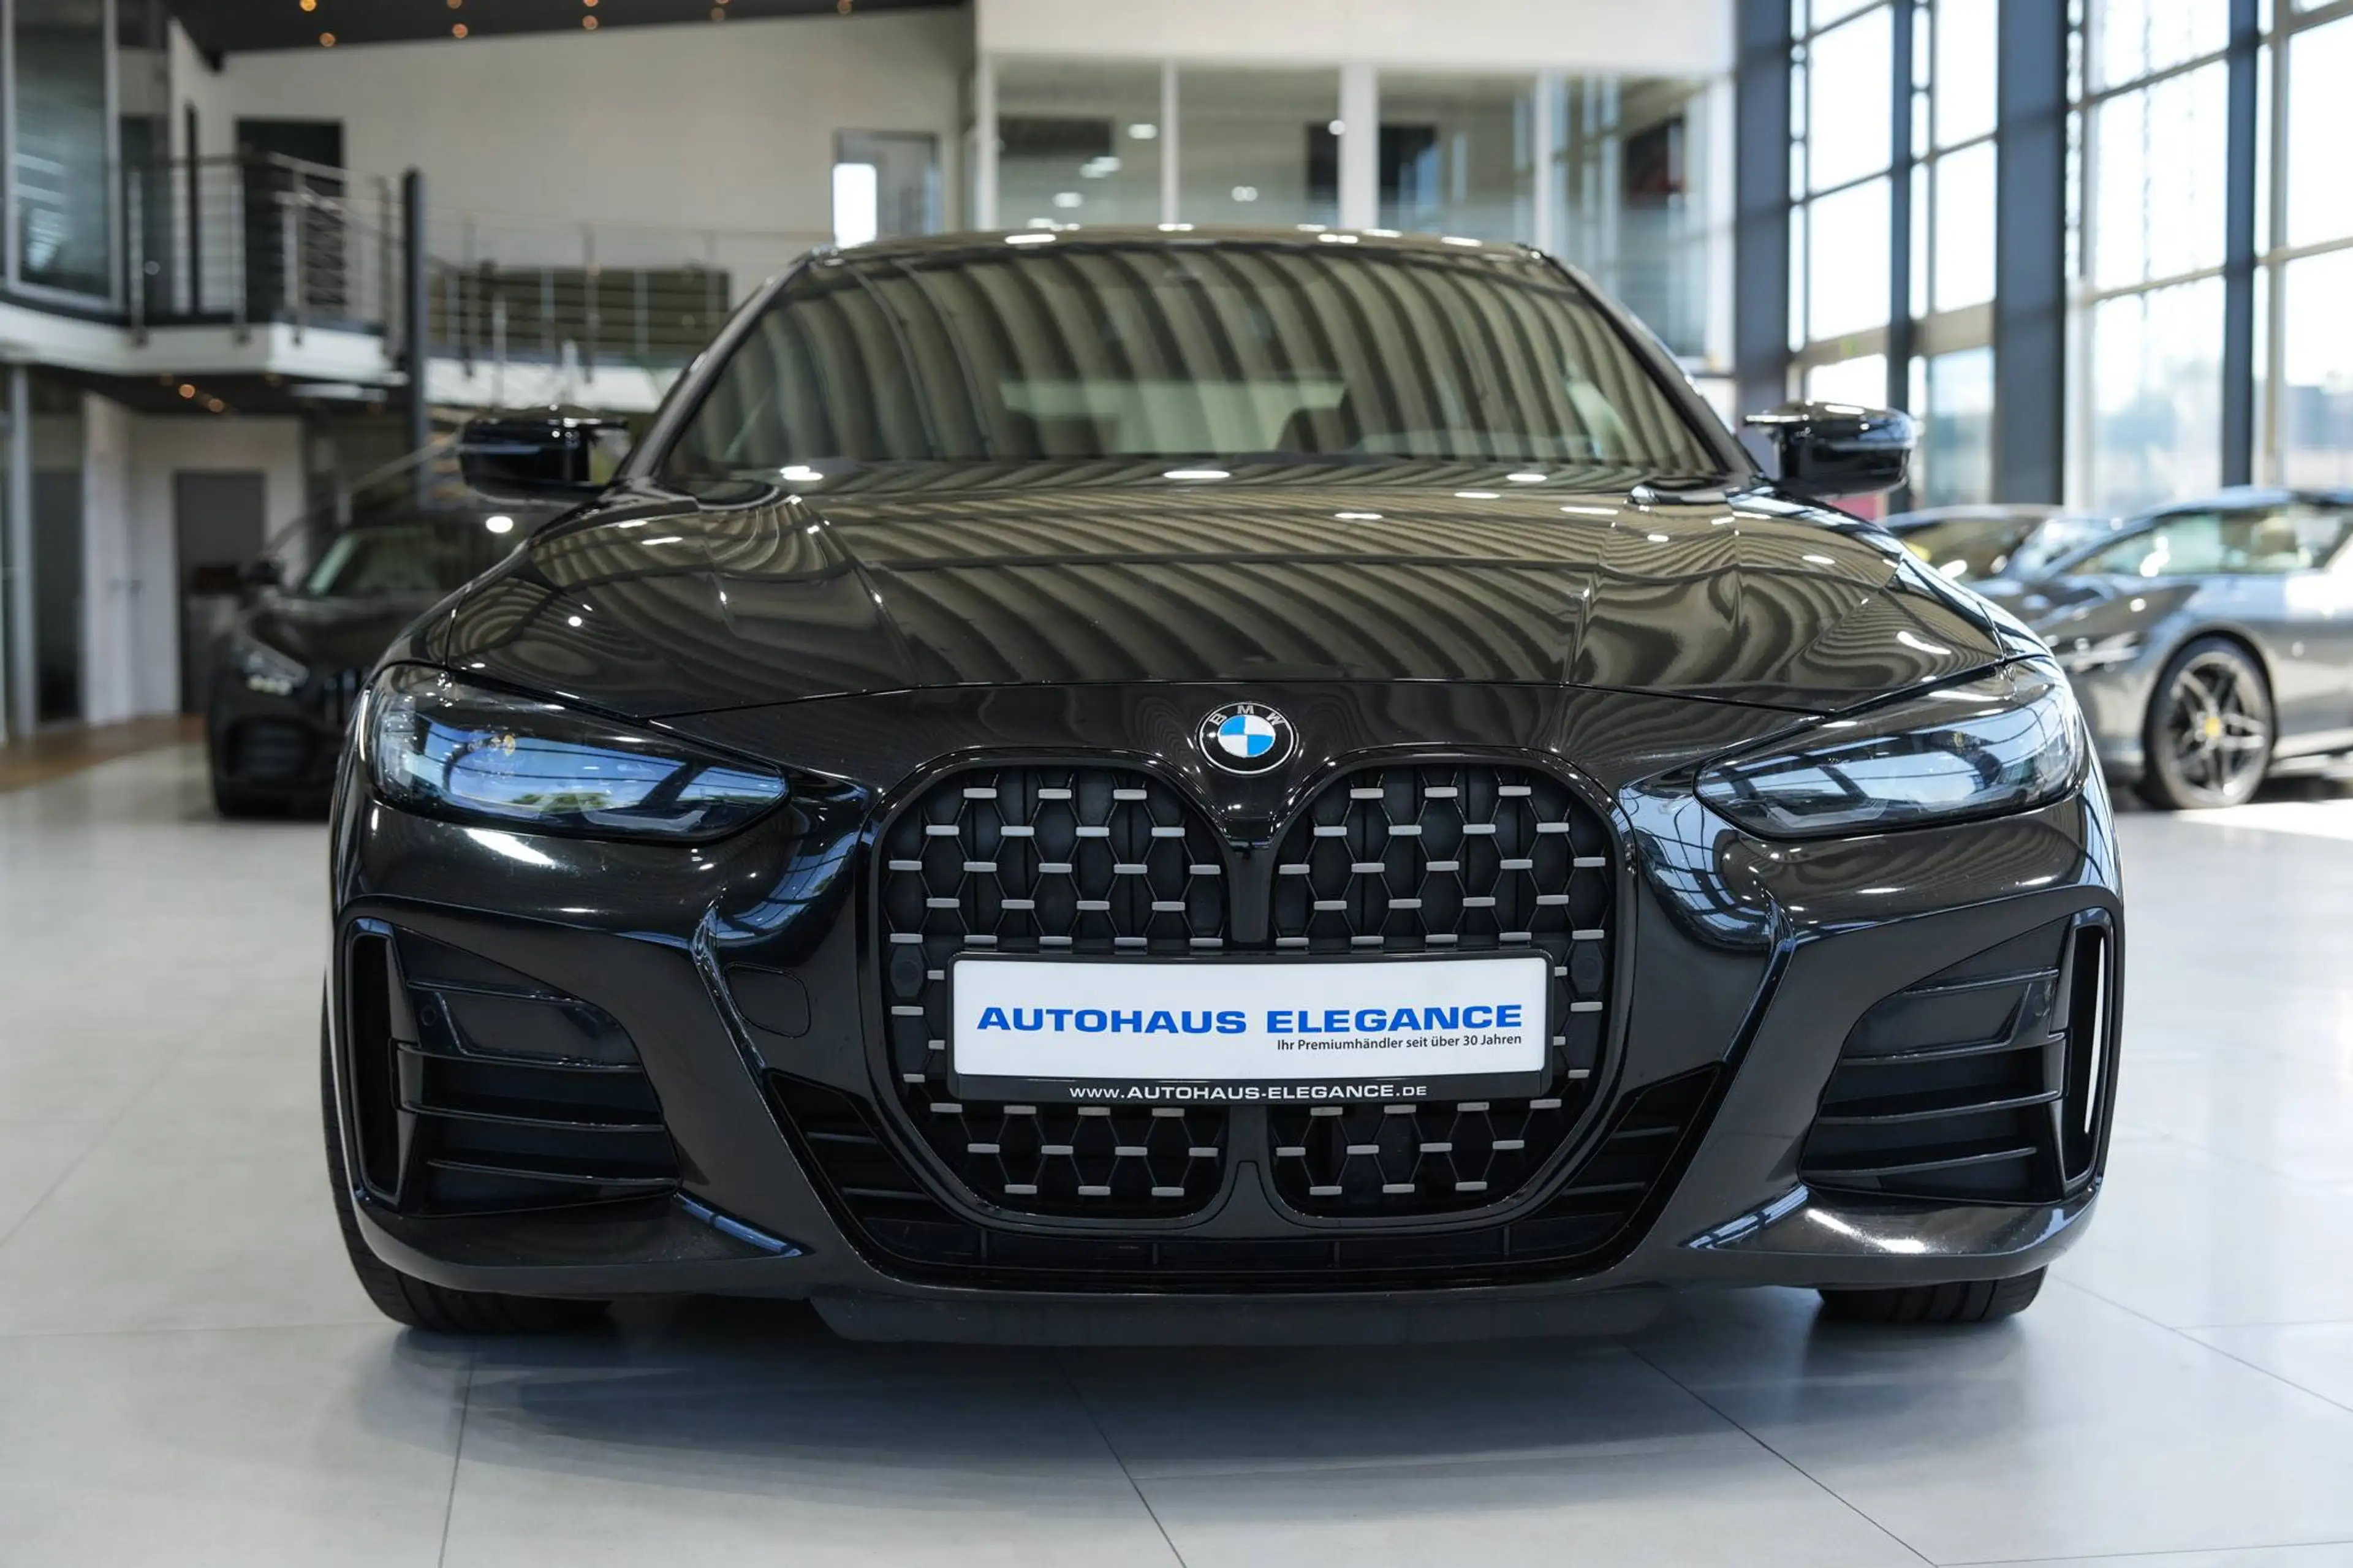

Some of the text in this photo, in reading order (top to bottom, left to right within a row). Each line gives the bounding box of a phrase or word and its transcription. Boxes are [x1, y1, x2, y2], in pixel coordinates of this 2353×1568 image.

[1209, 705, 1285, 726] BMW
[977, 1004, 1523, 1034] AUTOHAUS ELEGANCE
[1278, 1033, 1521, 1050] Ihr Premiumhändler seit über 30 Jahren
